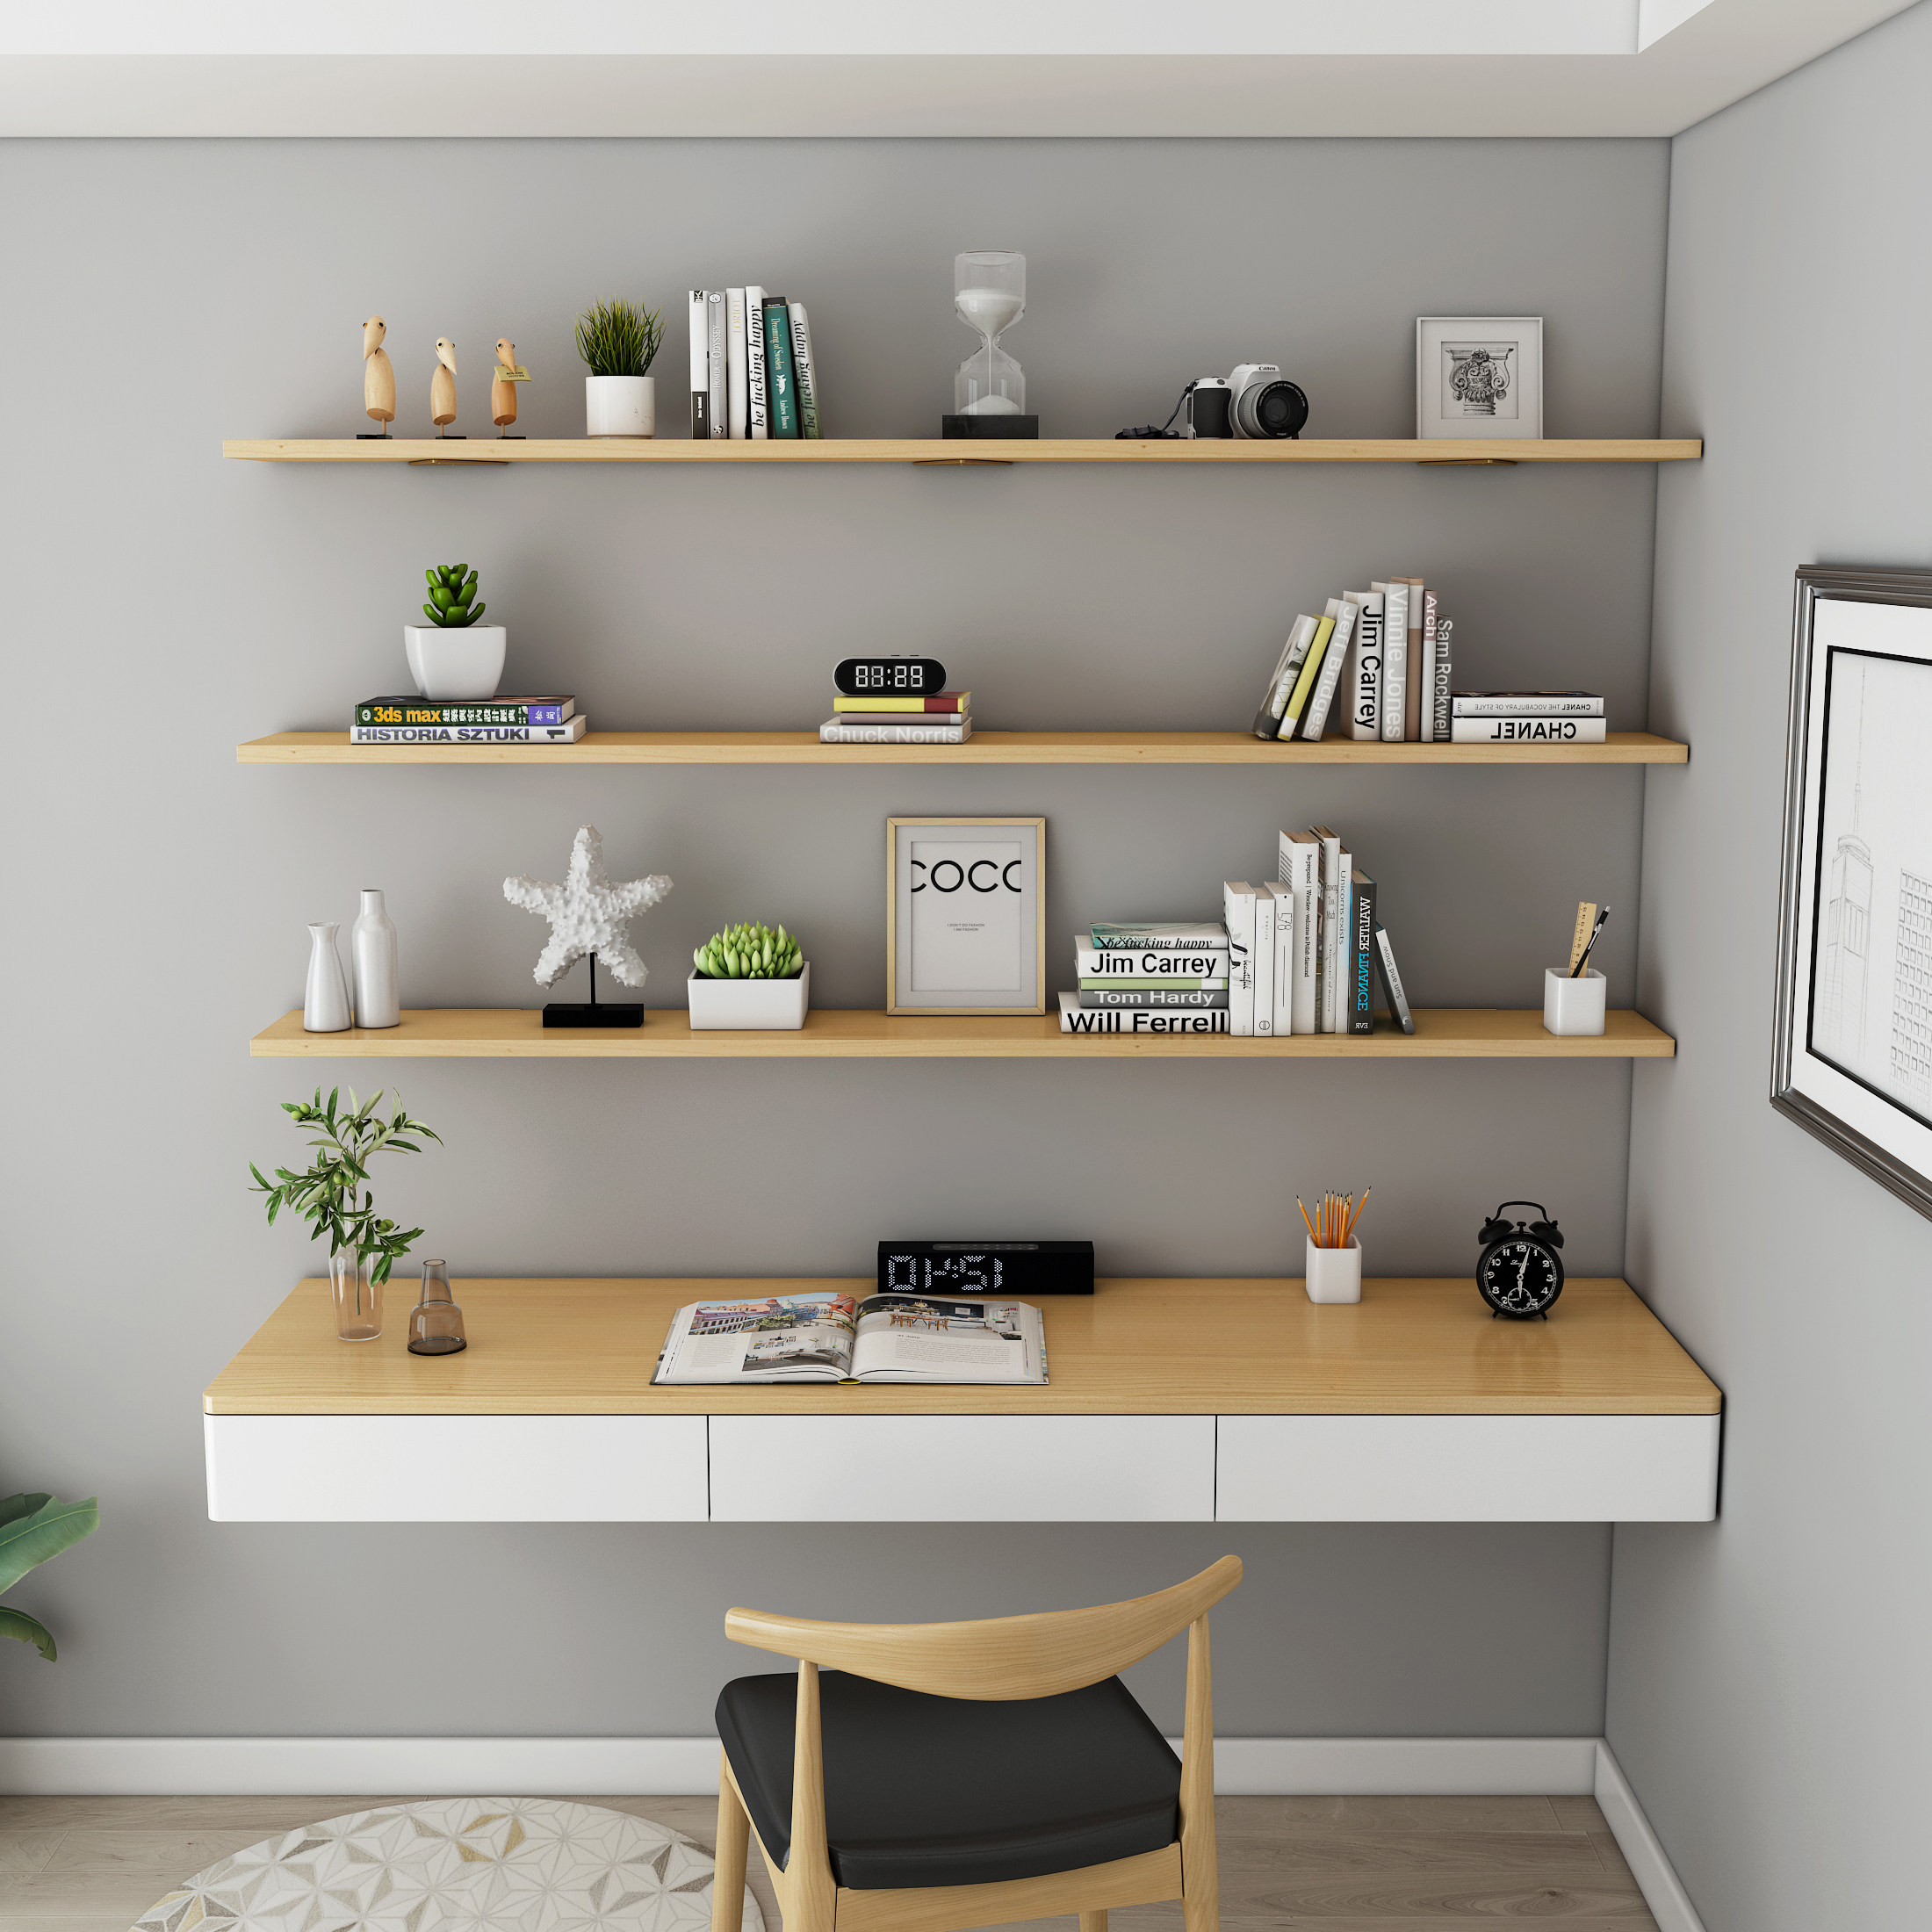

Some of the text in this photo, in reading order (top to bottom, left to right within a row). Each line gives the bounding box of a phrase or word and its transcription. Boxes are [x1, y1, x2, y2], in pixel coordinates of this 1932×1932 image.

[711, 325, 721, 358] ODYSSEY
[769, 318, 781, 343] Dreaming
[749, 306, 766, 427] be fucking happy
[774, 350, 784, 370] Sweden
[794, 321, 816, 429] be fucking happy
[779, 400, 789, 415] Andrew
[1425, 595, 1438, 637] Arch
[1308, 605, 1354, 738] Jeff Bridges
[1354, 605, 1382, 729] Jim Carrey
[1386, 589, 1409, 739] Vinnie Jones
[1434, 619, 1453, 739] Sam Rockwell
[373, 706, 442, 723] 3ds max
[357, 728, 452, 741] HISTORIA
[457, 728, 530, 741] SZTUKI
[824, 726, 960, 743] Chuck Norris
[1277, 912, 1293, 931] 578
[1174, 937, 1213, 949] happy
[1091, 953, 1217, 978] Jim Carrey
[1383, 946, 1402, 999] Sun and Snow
[1093, 991, 1215, 1007] Tom Hardy
[1067, 1012, 1121, 1033] Will
[1133, 1012, 1225, 1033] Ferrell
[1487, 1271, 1496, 1280] 9
[1492, 1286, 1500, 1294] 8
